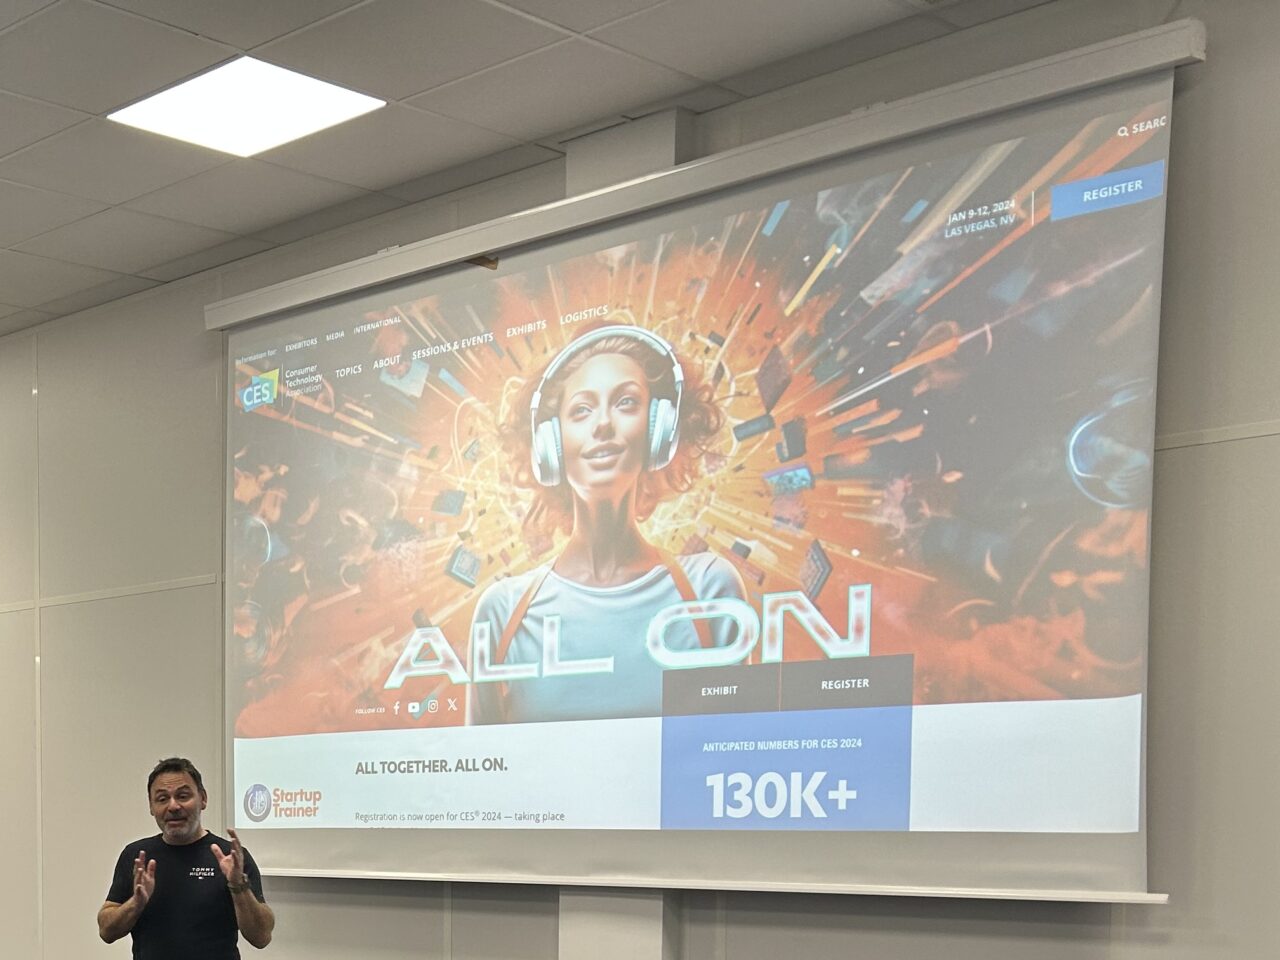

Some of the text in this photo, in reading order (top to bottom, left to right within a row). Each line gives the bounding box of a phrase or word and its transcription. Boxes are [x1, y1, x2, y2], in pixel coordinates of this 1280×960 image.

[1132, 116, 1167, 134] SEARC
[1083, 179, 1143, 203] REGISTER
[947, 199, 1016, 225] JAN 9-12, 2024
[944, 213, 1017, 239] LAS VEGAS, NV
[285, 337, 318, 352] EXHIBITORS
[326, 330, 345, 342] MEDIA
[353, 315, 401, 334] INTERNATIONAL
[335, 305, 609, 379] TOPICS ABOUT SESSIONS & EVENTS EXHIBITS LOGISTICS
[285, 364, 318, 378] Consumer
[285, 373, 323, 389] Technology
[243, 382, 270, 406] CES
[285, 384, 322, 398] Association
[384, 583, 872, 691] ALL ON
[701, 685, 738, 696] EXHIBIT
[821, 678, 870, 690] REGISTER
[702, 738, 862, 753] ANTICIPATED NUMBERS FOR CES 2024
[355, 757, 508, 775] ALL TOGETHER. ALL ON.
[272, 787, 322, 806] Startup
[706, 771, 857, 818] 130K+
[272, 803, 319, 818] Trainer
[355, 812, 398, 823] Registration
[399, 812, 405, 821] is
[424, 814, 445, 823] open
[446, 811, 458, 821] for
[481, 811, 501, 821] 2024
[514, 812, 540, 823] taking
[542, 811, 565, 823] place
